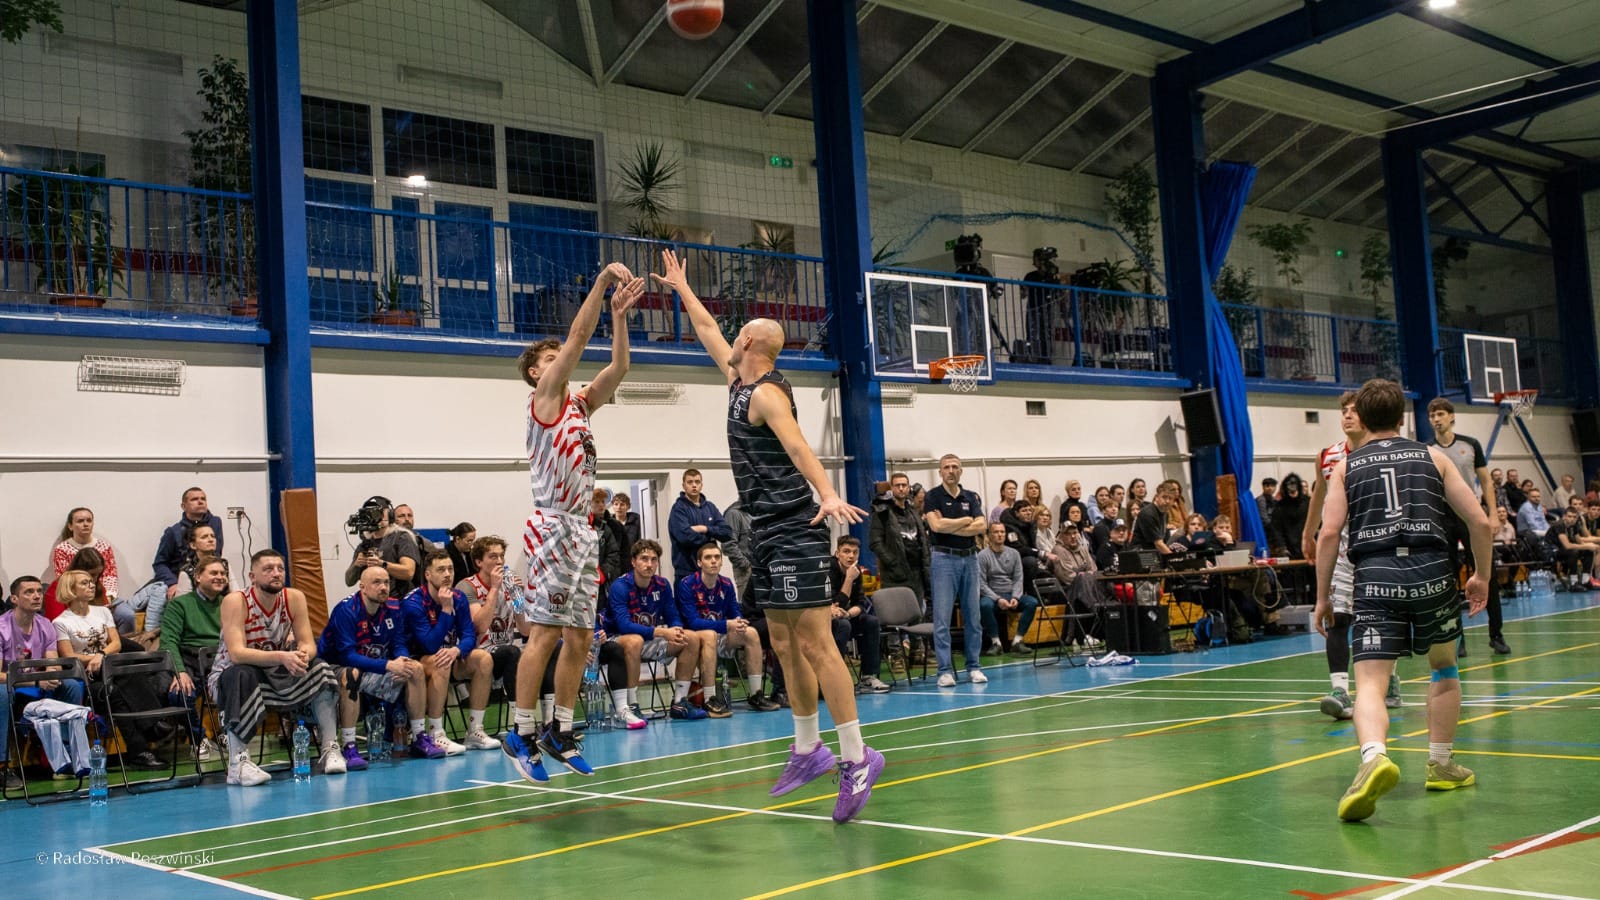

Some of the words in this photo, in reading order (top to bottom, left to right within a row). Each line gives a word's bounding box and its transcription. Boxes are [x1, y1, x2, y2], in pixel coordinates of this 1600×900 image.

[1350, 458, 1367, 469] KKS
[1368, 455, 1389, 463] TUR
[1390, 452, 1426, 461] BASKET
[1380, 467, 1403, 519] 1
[1357, 527, 1388, 540] BIELSK
[783, 575, 799, 602] 5
